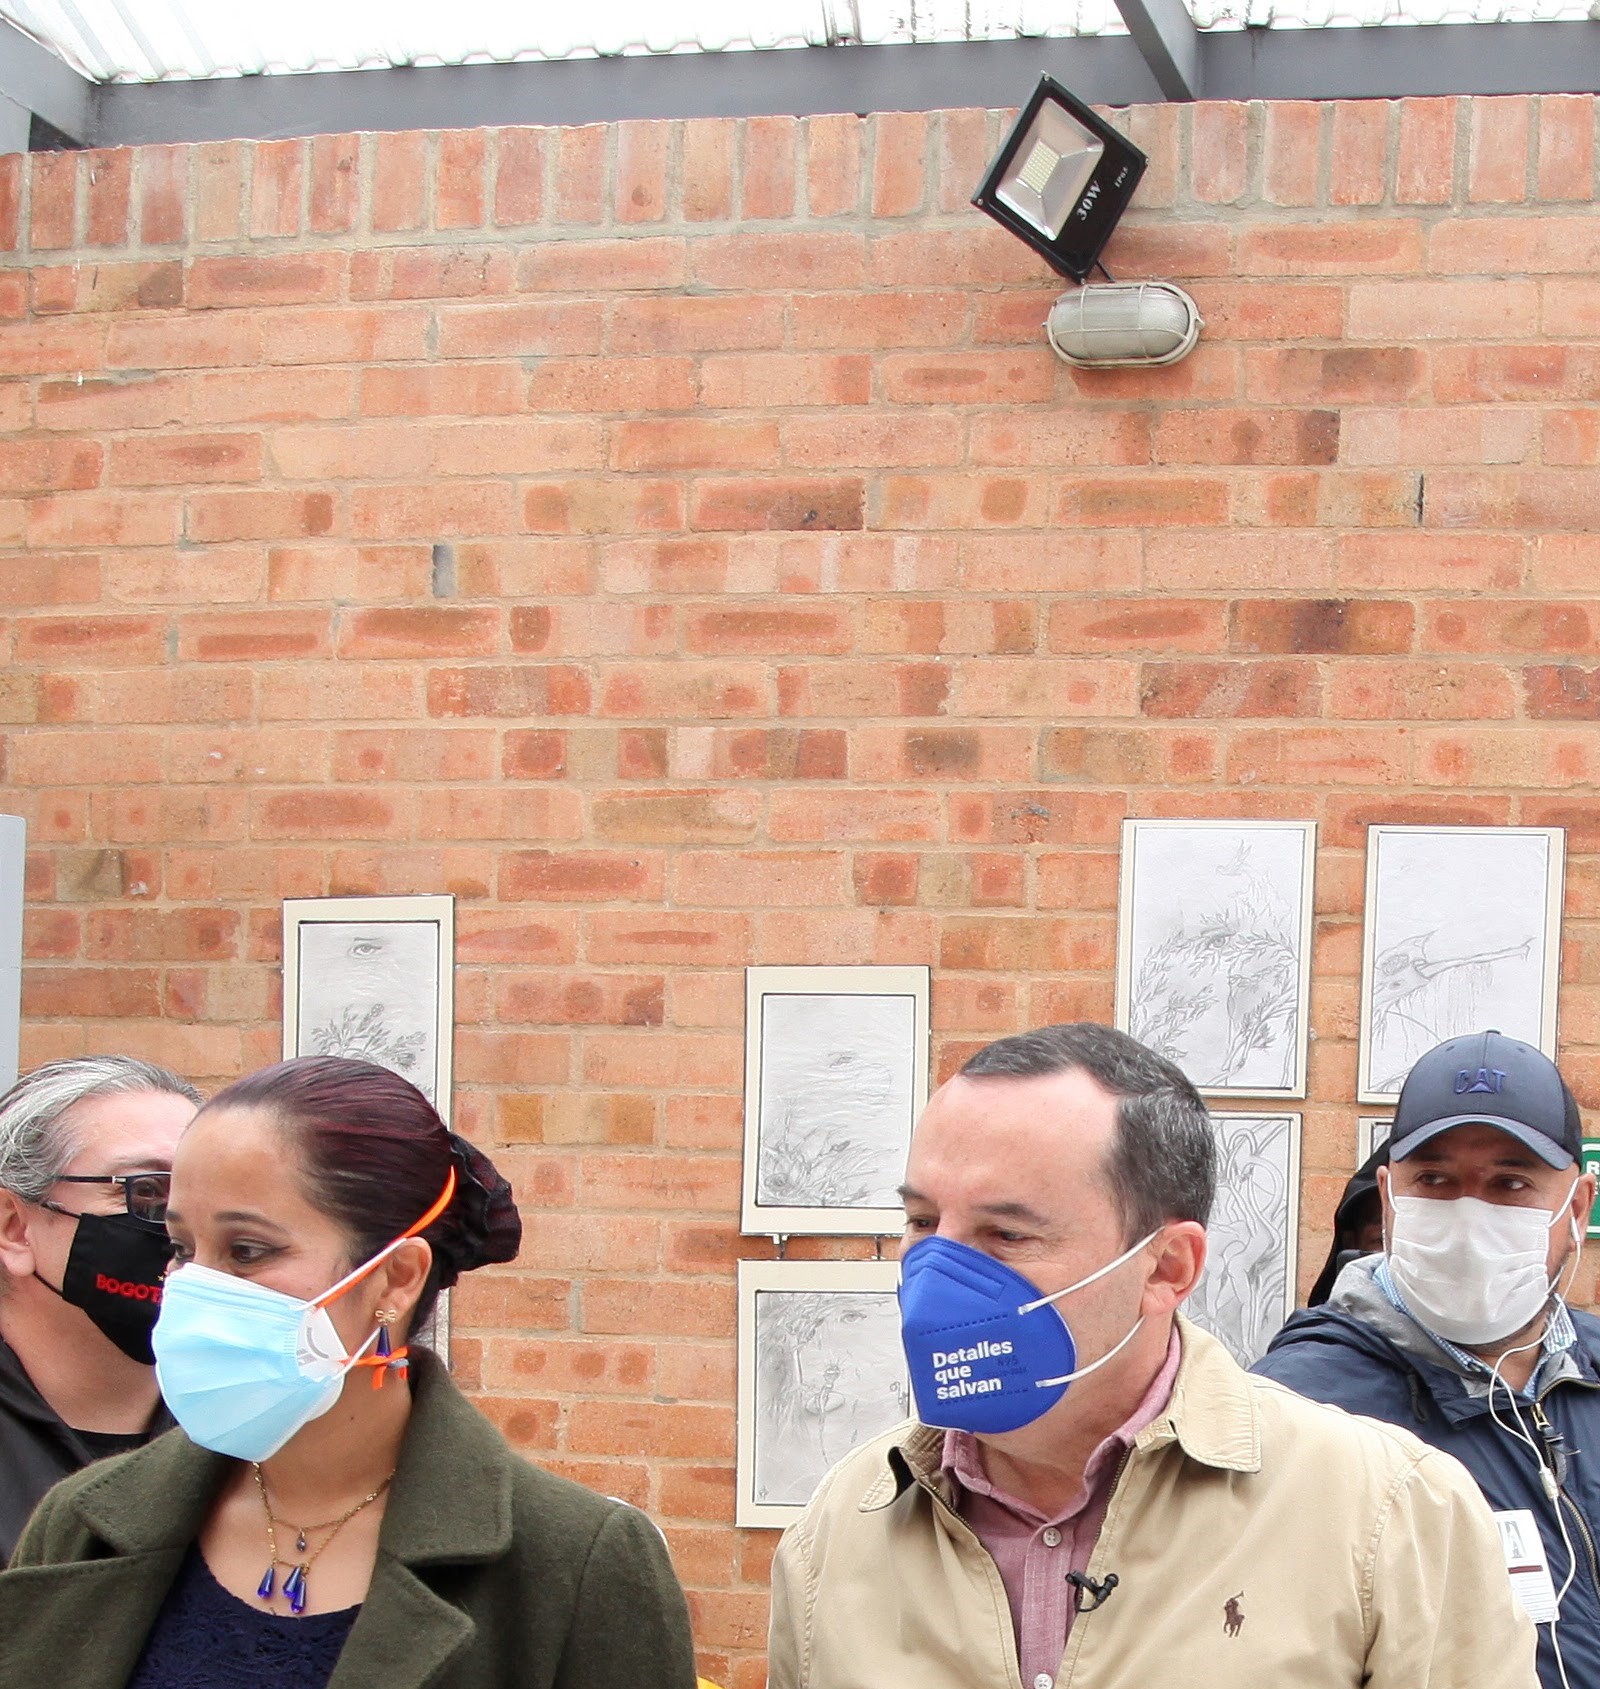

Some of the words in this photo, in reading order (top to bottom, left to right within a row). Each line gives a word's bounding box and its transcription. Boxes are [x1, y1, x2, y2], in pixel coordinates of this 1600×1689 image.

[1076, 180, 1101, 221] 30W
[1455, 1068, 1506, 1094] CAT
[95, 1273, 161, 1303] BOGOT
[933, 1340, 1014, 1369] Detalles
[934, 1365, 973, 1386] que
[936, 1377, 1002, 1400] salvan
